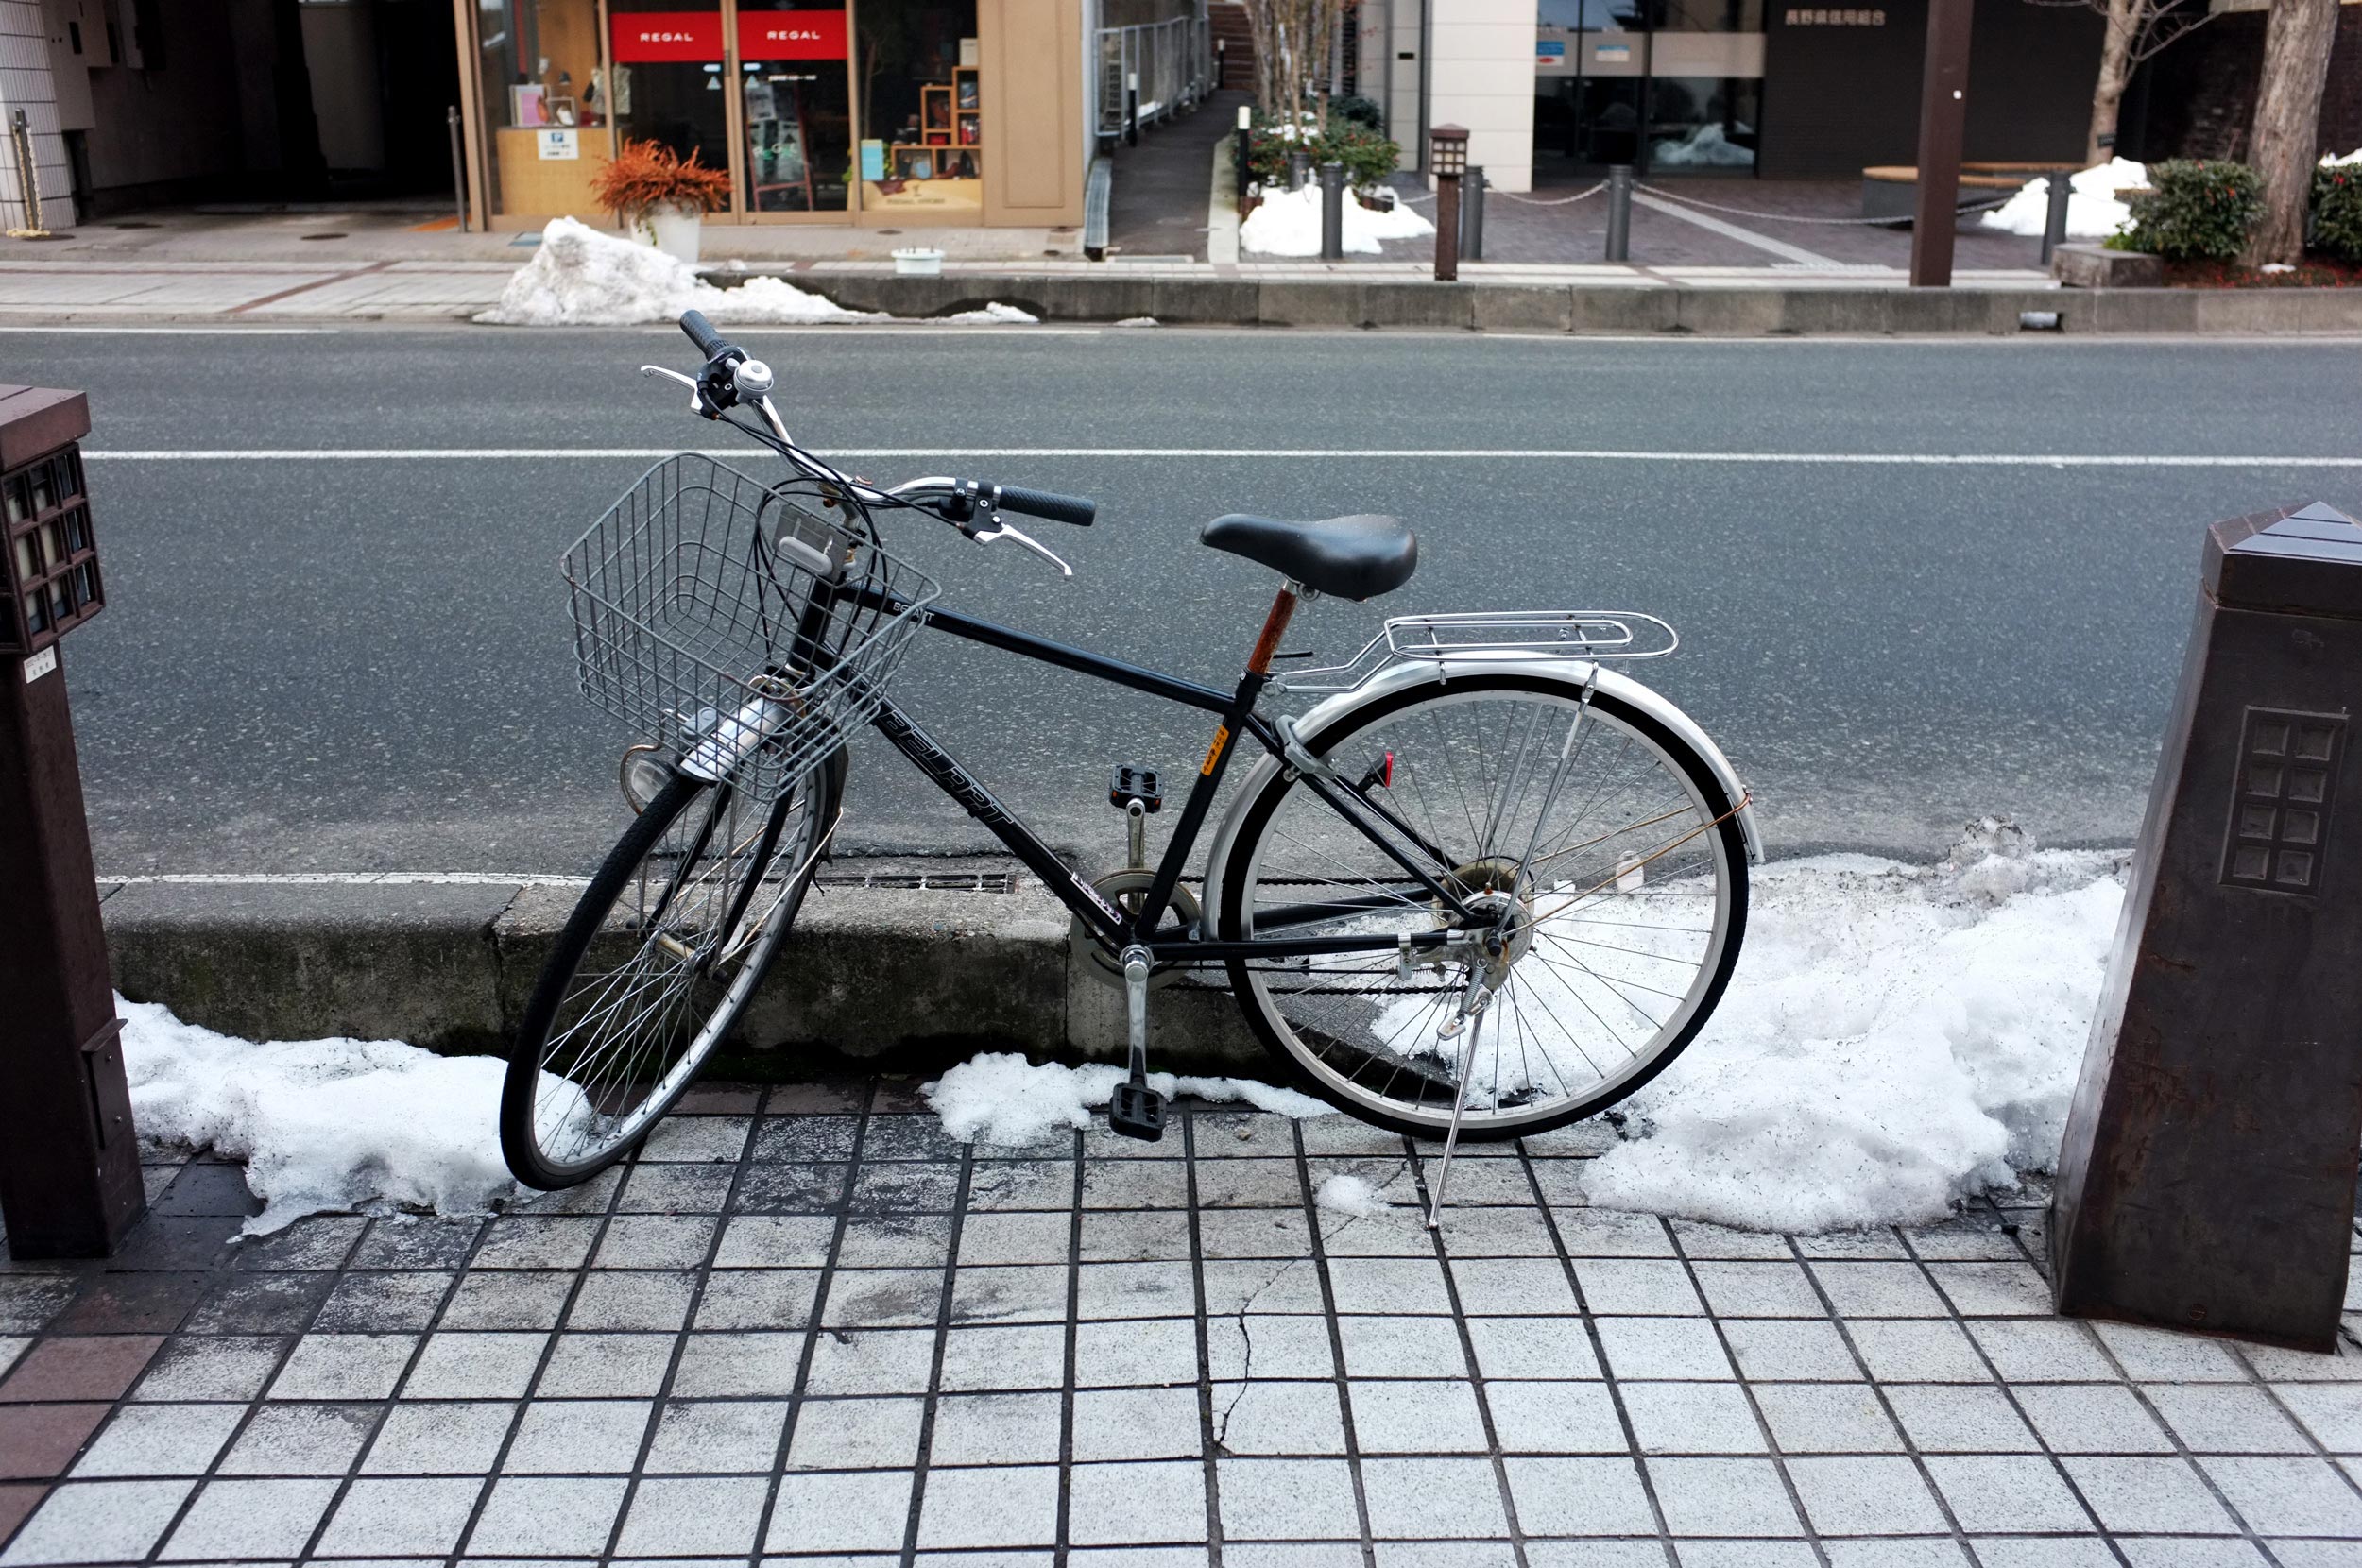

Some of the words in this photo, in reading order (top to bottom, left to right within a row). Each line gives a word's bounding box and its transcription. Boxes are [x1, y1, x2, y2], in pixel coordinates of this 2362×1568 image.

[640, 32, 693, 43] REGAL
[767, 30, 820, 41] REGAL
[893, 601, 935, 622] BEAT
